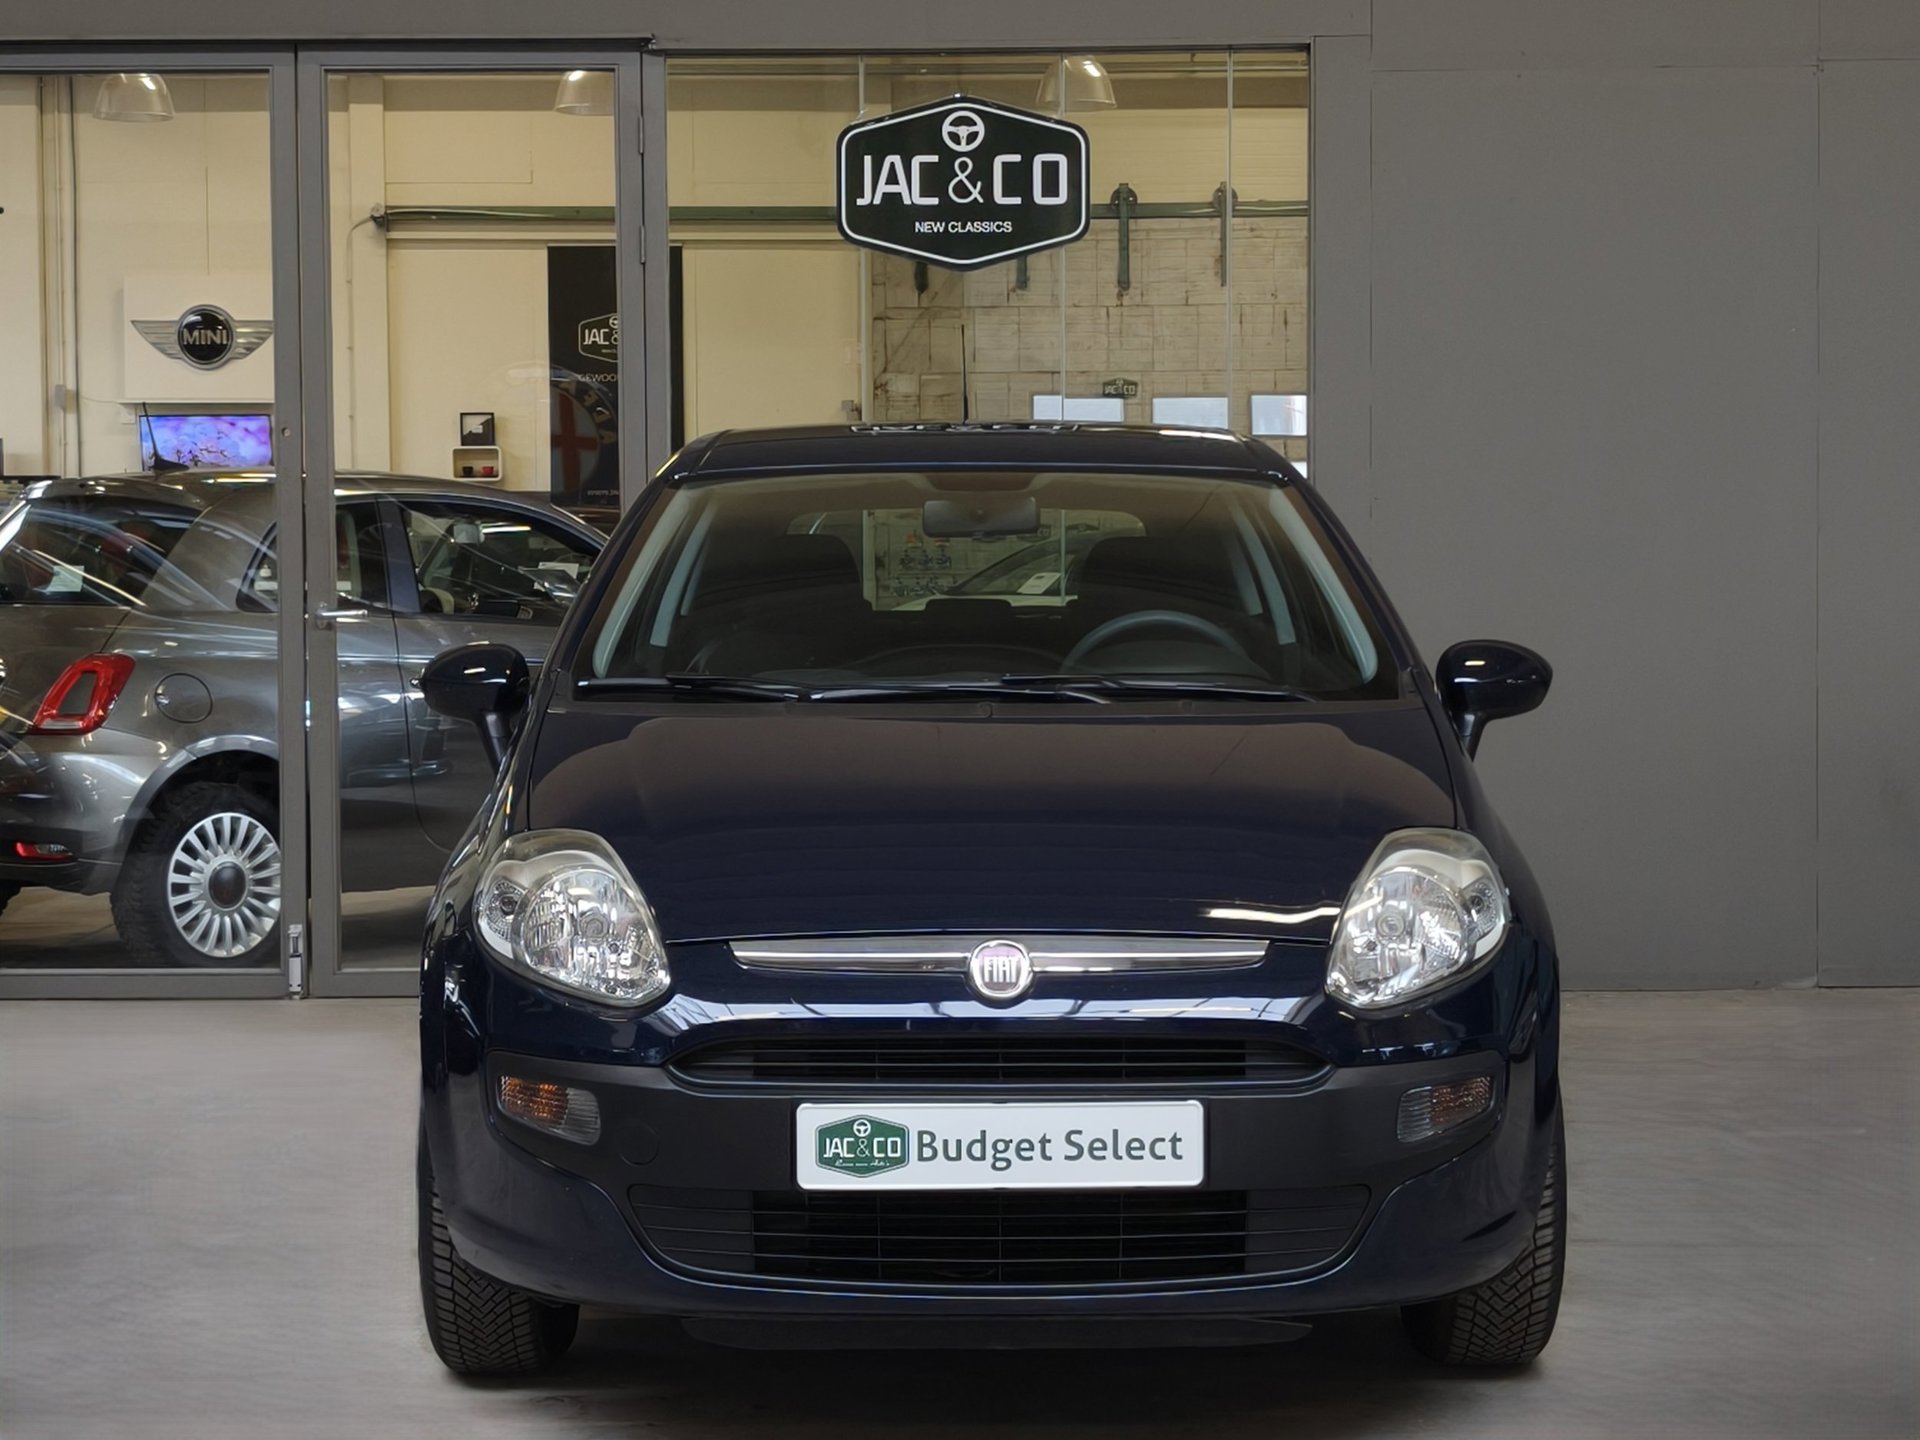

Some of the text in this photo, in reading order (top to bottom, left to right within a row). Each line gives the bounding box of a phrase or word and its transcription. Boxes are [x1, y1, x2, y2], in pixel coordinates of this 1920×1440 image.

[914, 221, 1013, 233] NEW CLASSICS
[182, 327, 229, 345] MINI
[983, 956, 1020, 983] FIAT
[916, 1128, 1184, 1171] Budget Select
